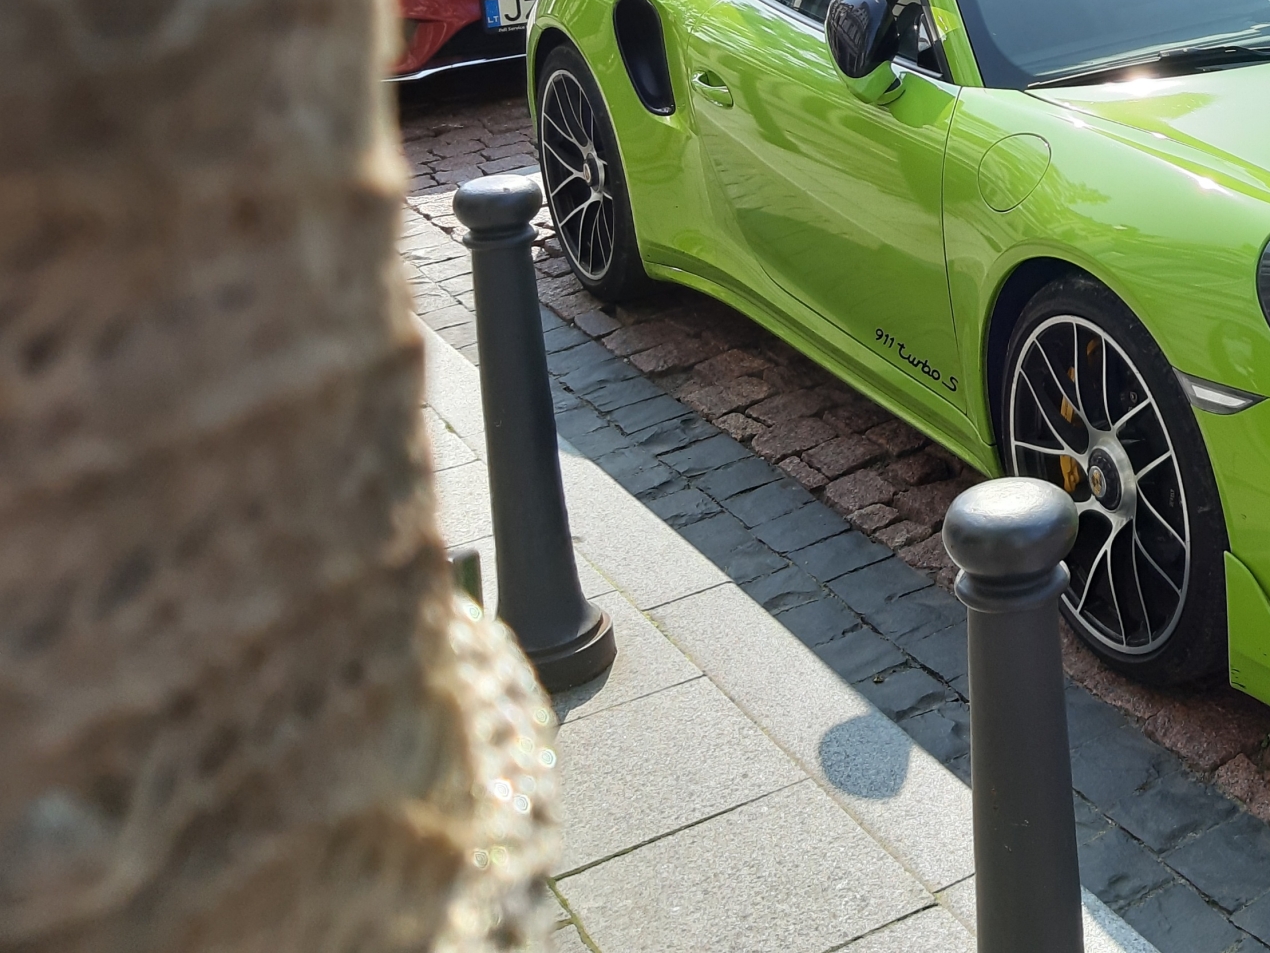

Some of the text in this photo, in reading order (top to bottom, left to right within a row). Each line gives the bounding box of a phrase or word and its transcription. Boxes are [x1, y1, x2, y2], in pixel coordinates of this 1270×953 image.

[487, 15, 499, 24] LT
[875, 328, 959, 392] 911 turbo S
